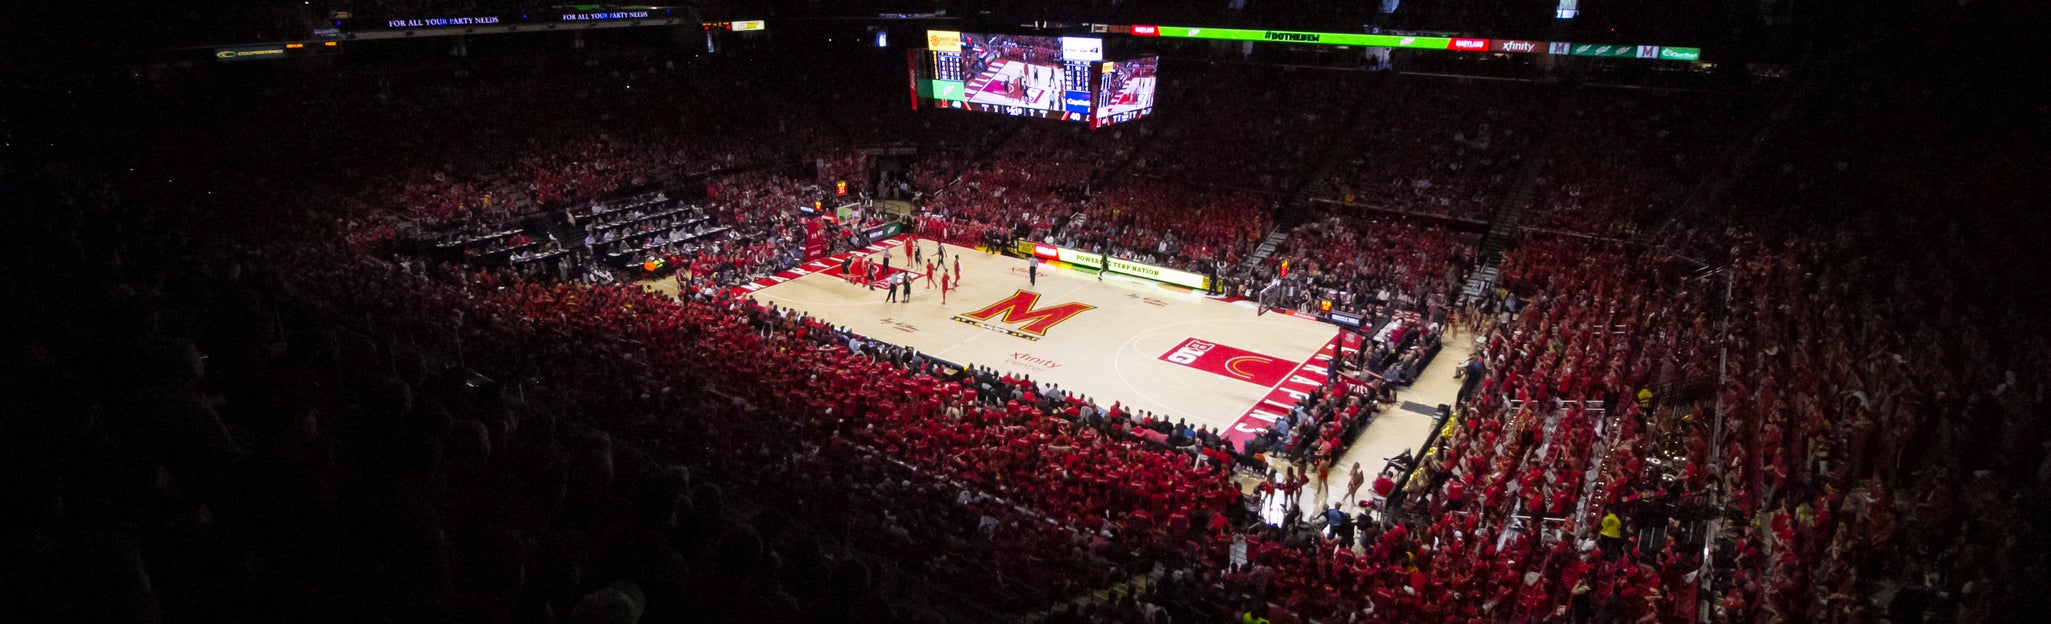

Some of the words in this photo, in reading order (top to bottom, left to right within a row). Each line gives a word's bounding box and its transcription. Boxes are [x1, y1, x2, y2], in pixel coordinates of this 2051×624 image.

[388, 20, 406, 28] FOR
[408, 19, 423, 27] ALL
[424, 18, 447, 26] YOUR
[449, 17, 474, 26] PARTY
[475, 16, 499, 25] NEEDS
[563, 13, 576, 21] FOR
[591, 12, 608, 20] YOUR
[609, 11, 629, 19] PARTY
[1455, 40, 1484, 48] MARYLAND
[1502, 40, 1535, 52] xfinity
[1642, 46, 1653, 57] M
[1076, 254, 1111, 267] POWERG
[1113, 261, 1131, 271] TERP
[1131, 265, 1160, 276] NATION
[962, 289, 1098, 337] M
[1009, 352, 1062, 369] xfinity
